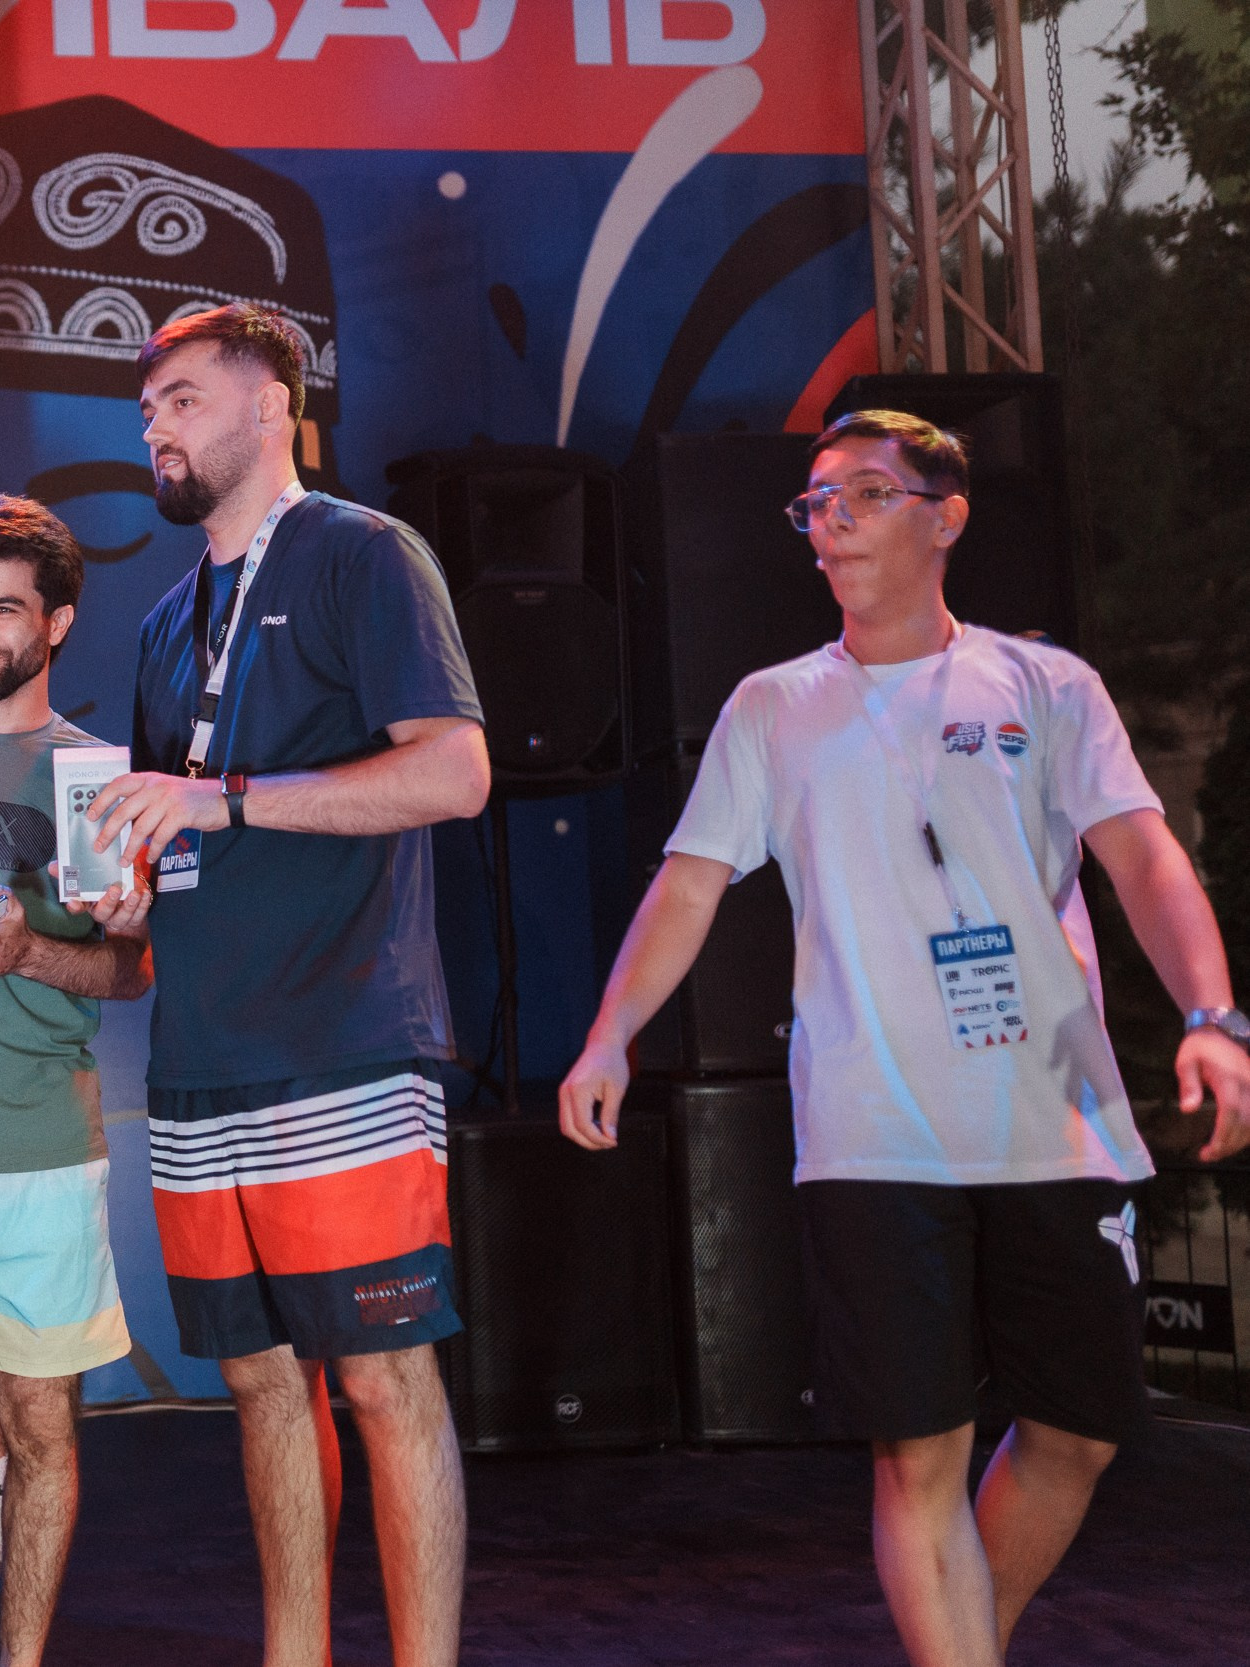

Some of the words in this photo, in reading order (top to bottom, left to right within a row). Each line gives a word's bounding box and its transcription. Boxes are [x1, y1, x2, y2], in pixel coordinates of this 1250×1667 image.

[215, 623, 228, 649] NOR
[997, 733, 1027, 746] PEPSI
[69, 770, 99, 779] HONOR
[160, 851, 198, 872] ПАРТНЕРЫ
[936, 932, 1008, 956] ПАРТНЕРЫ
[971, 963, 1011, 978] TROPIC
[354, 1289, 397, 1301] ORIGINAL
[403, 1276, 437, 1293] QUALITY
